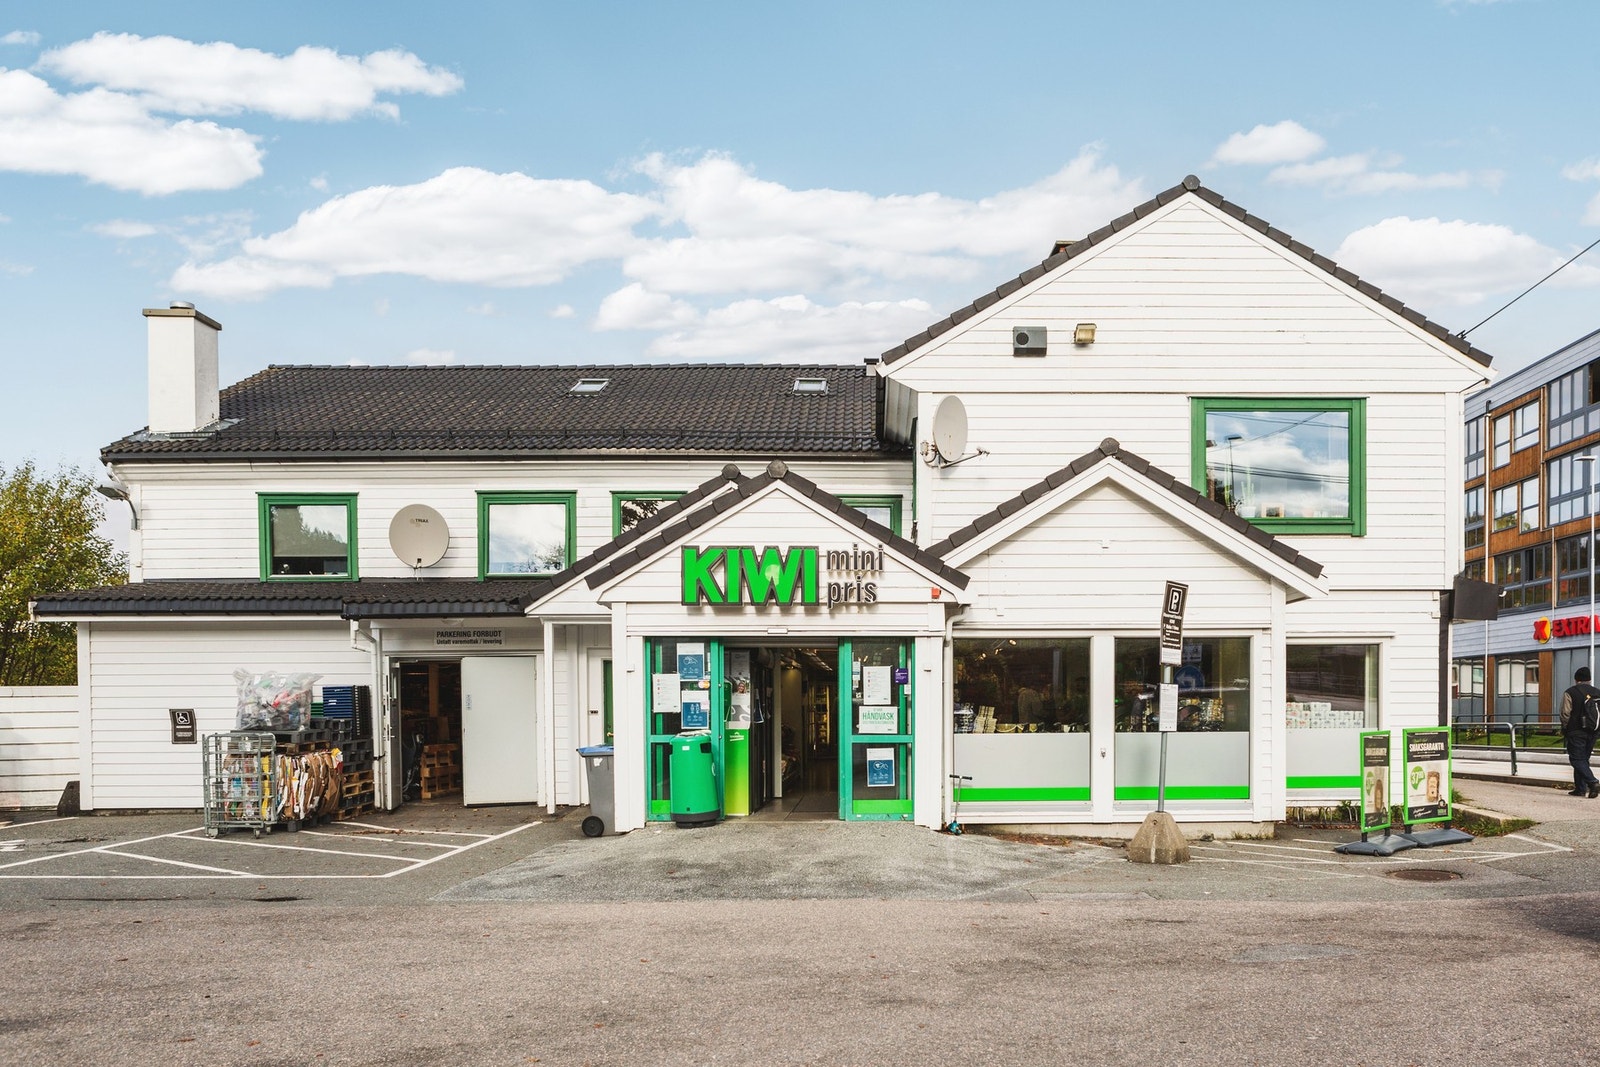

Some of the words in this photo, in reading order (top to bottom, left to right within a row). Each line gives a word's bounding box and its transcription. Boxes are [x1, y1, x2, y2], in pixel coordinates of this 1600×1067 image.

[681, 545, 820, 607] KIWI
[826, 543, 884, 571] mini
[826, 575, 878, 609] pris
[862, 710, 894, 720] HÅNDVASK
